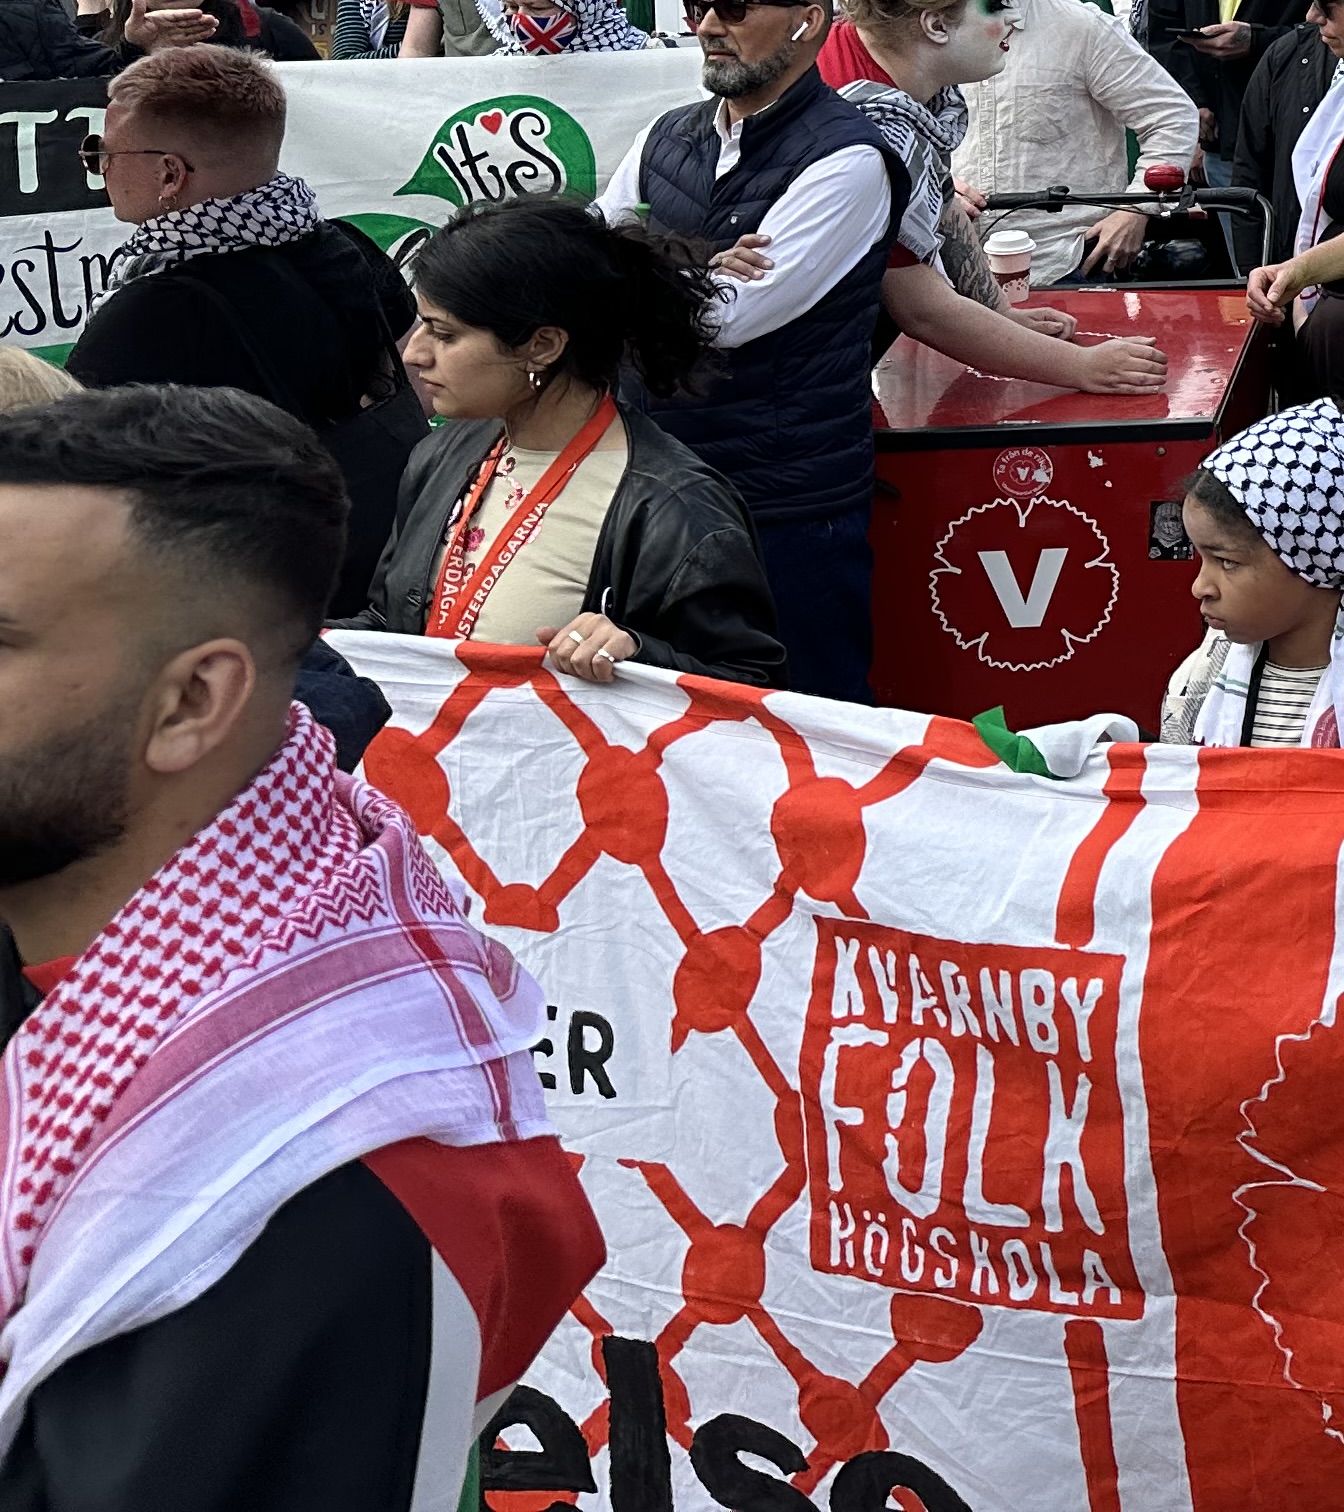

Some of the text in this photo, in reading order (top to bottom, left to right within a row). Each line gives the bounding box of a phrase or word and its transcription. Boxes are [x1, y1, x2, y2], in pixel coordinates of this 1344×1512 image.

[977, 547, 1069, 628] V
[830, 935, 1106, 1064] KVARNBY
[819, 1024, 1107, 1235] FOLK
